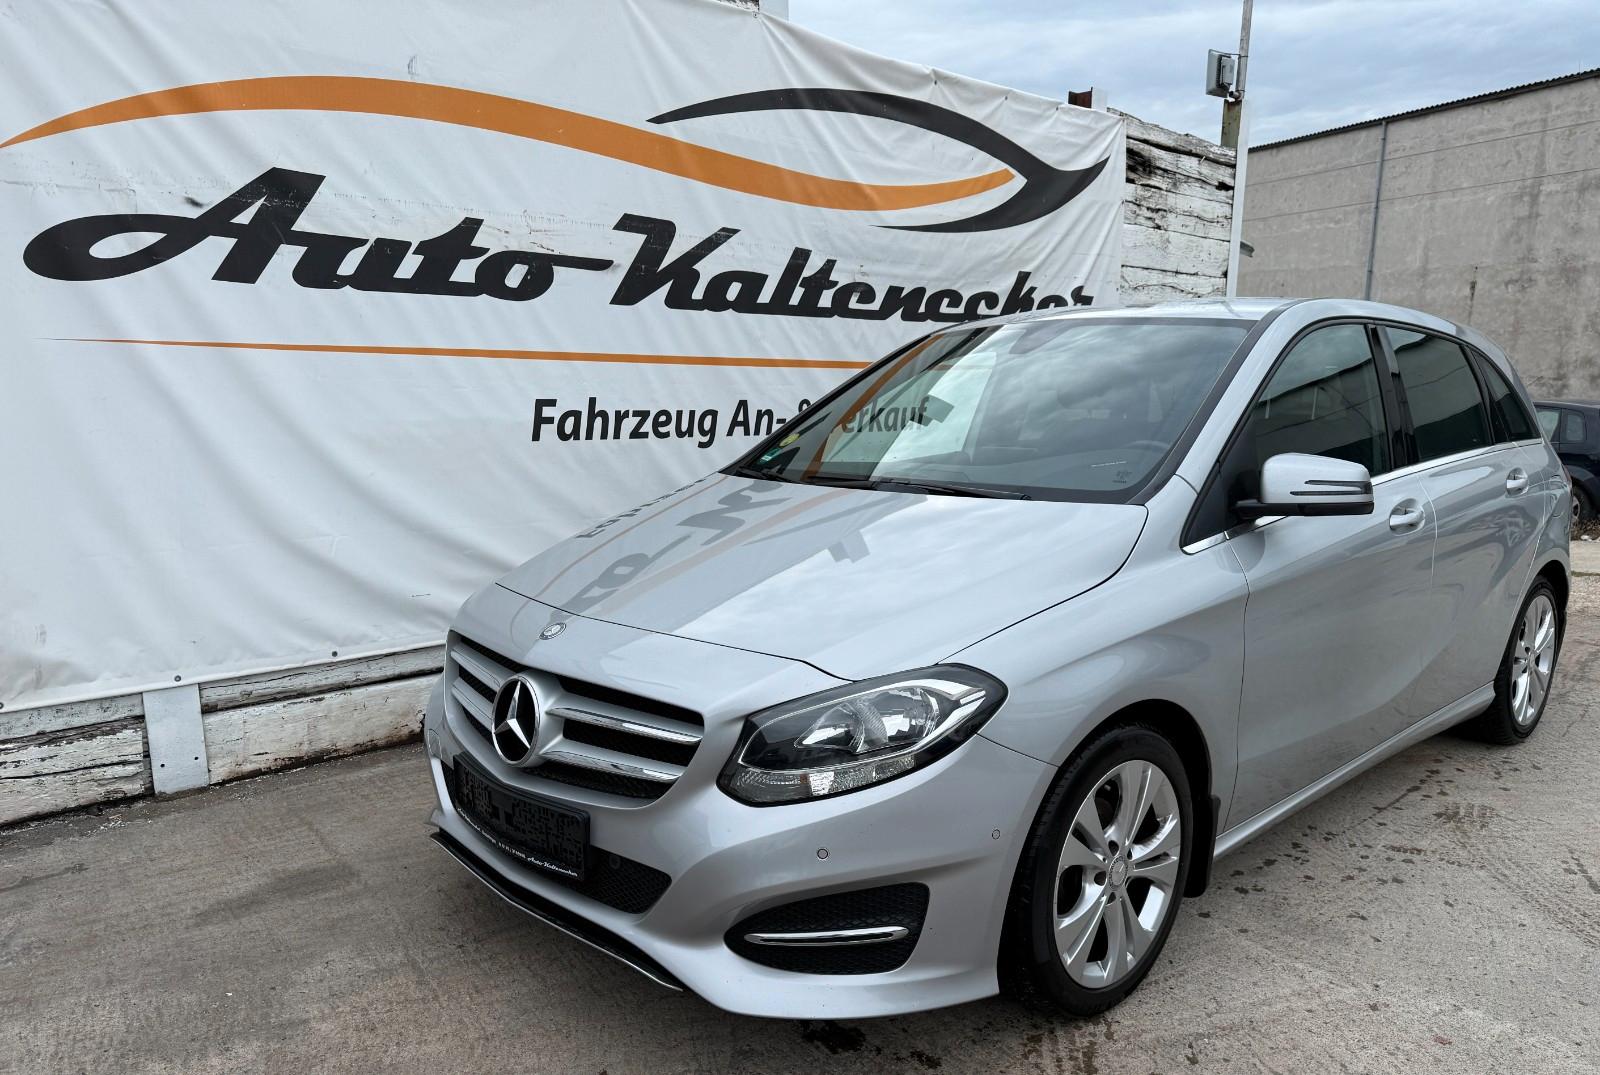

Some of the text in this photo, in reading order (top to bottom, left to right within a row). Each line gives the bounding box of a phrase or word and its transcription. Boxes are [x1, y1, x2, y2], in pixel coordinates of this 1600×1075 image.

[23, 167, 614, 302] Auto
[531, 395, 930, 449] Fahrzeug An- erkauf
